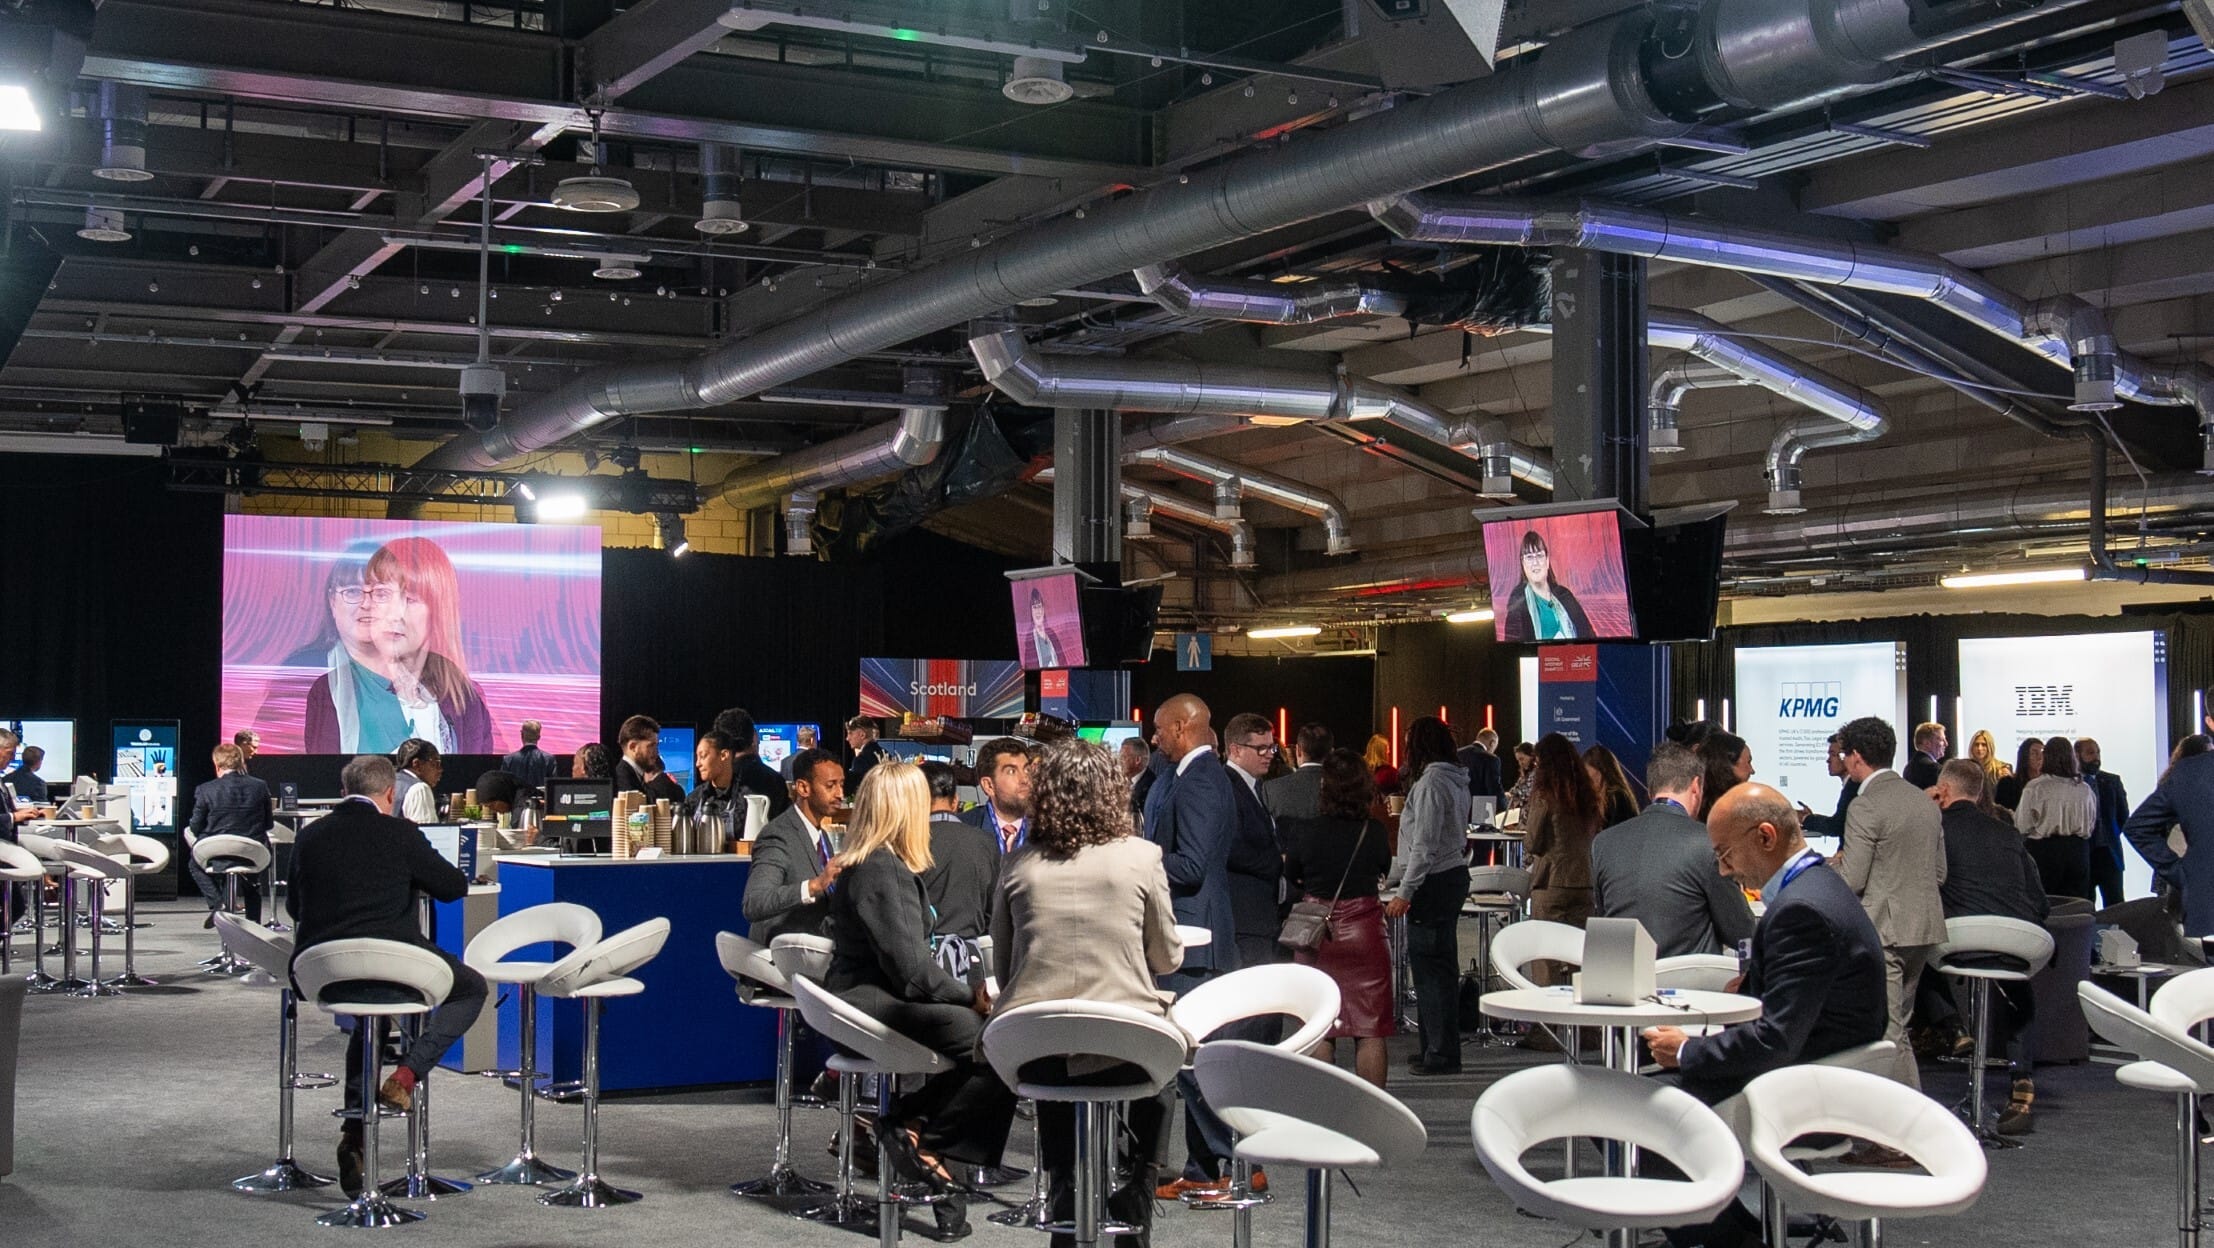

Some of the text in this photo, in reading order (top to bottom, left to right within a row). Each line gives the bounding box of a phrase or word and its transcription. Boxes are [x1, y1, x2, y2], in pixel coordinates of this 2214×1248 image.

[910, 681, 977, 696] Scotland
[1779, 697, 1839, 718] KPMG
[2015, 685, 2074, 716] IBM
